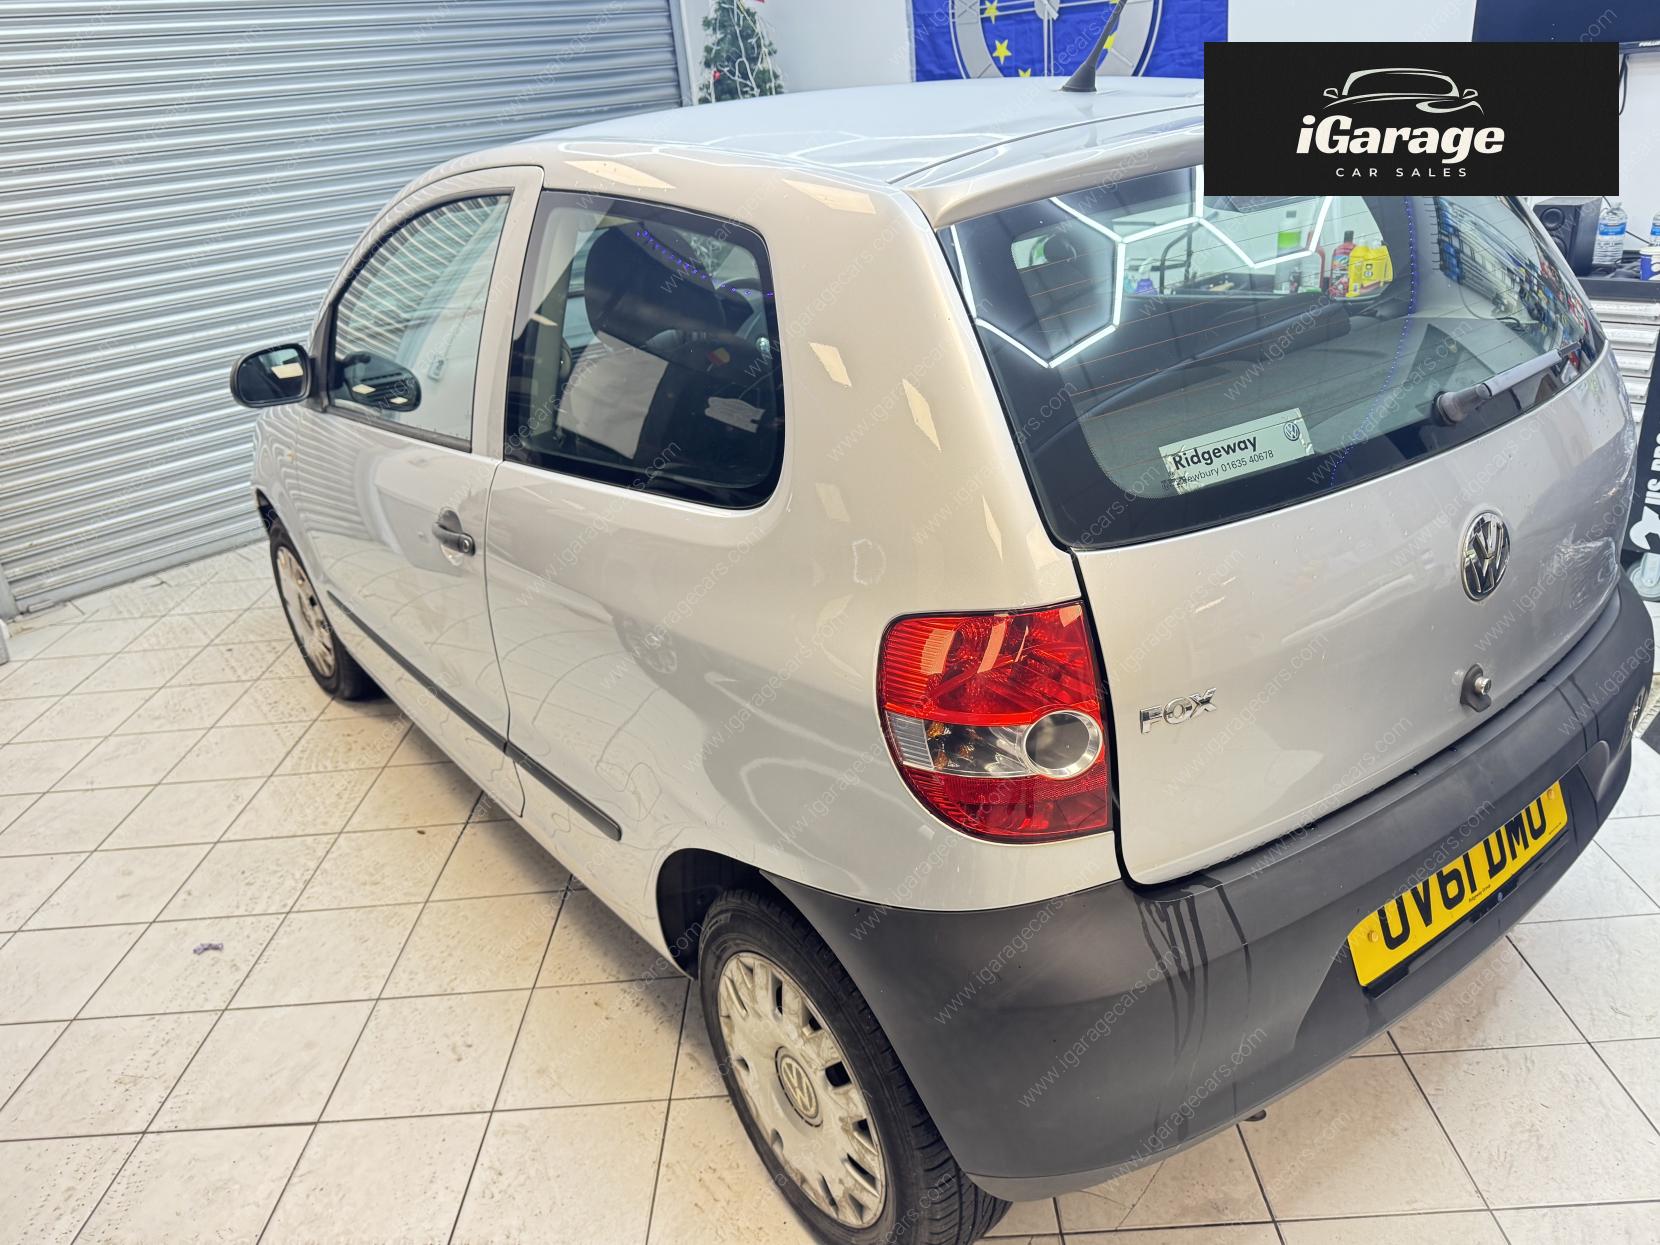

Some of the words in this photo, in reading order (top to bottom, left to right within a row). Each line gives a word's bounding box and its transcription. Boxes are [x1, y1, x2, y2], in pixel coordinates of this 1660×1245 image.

[1172, 436, 1257, 470] Ridgeway
[1249, 449, 1274, 464] 40678
[1139, 687, 1217, 734] FOX
